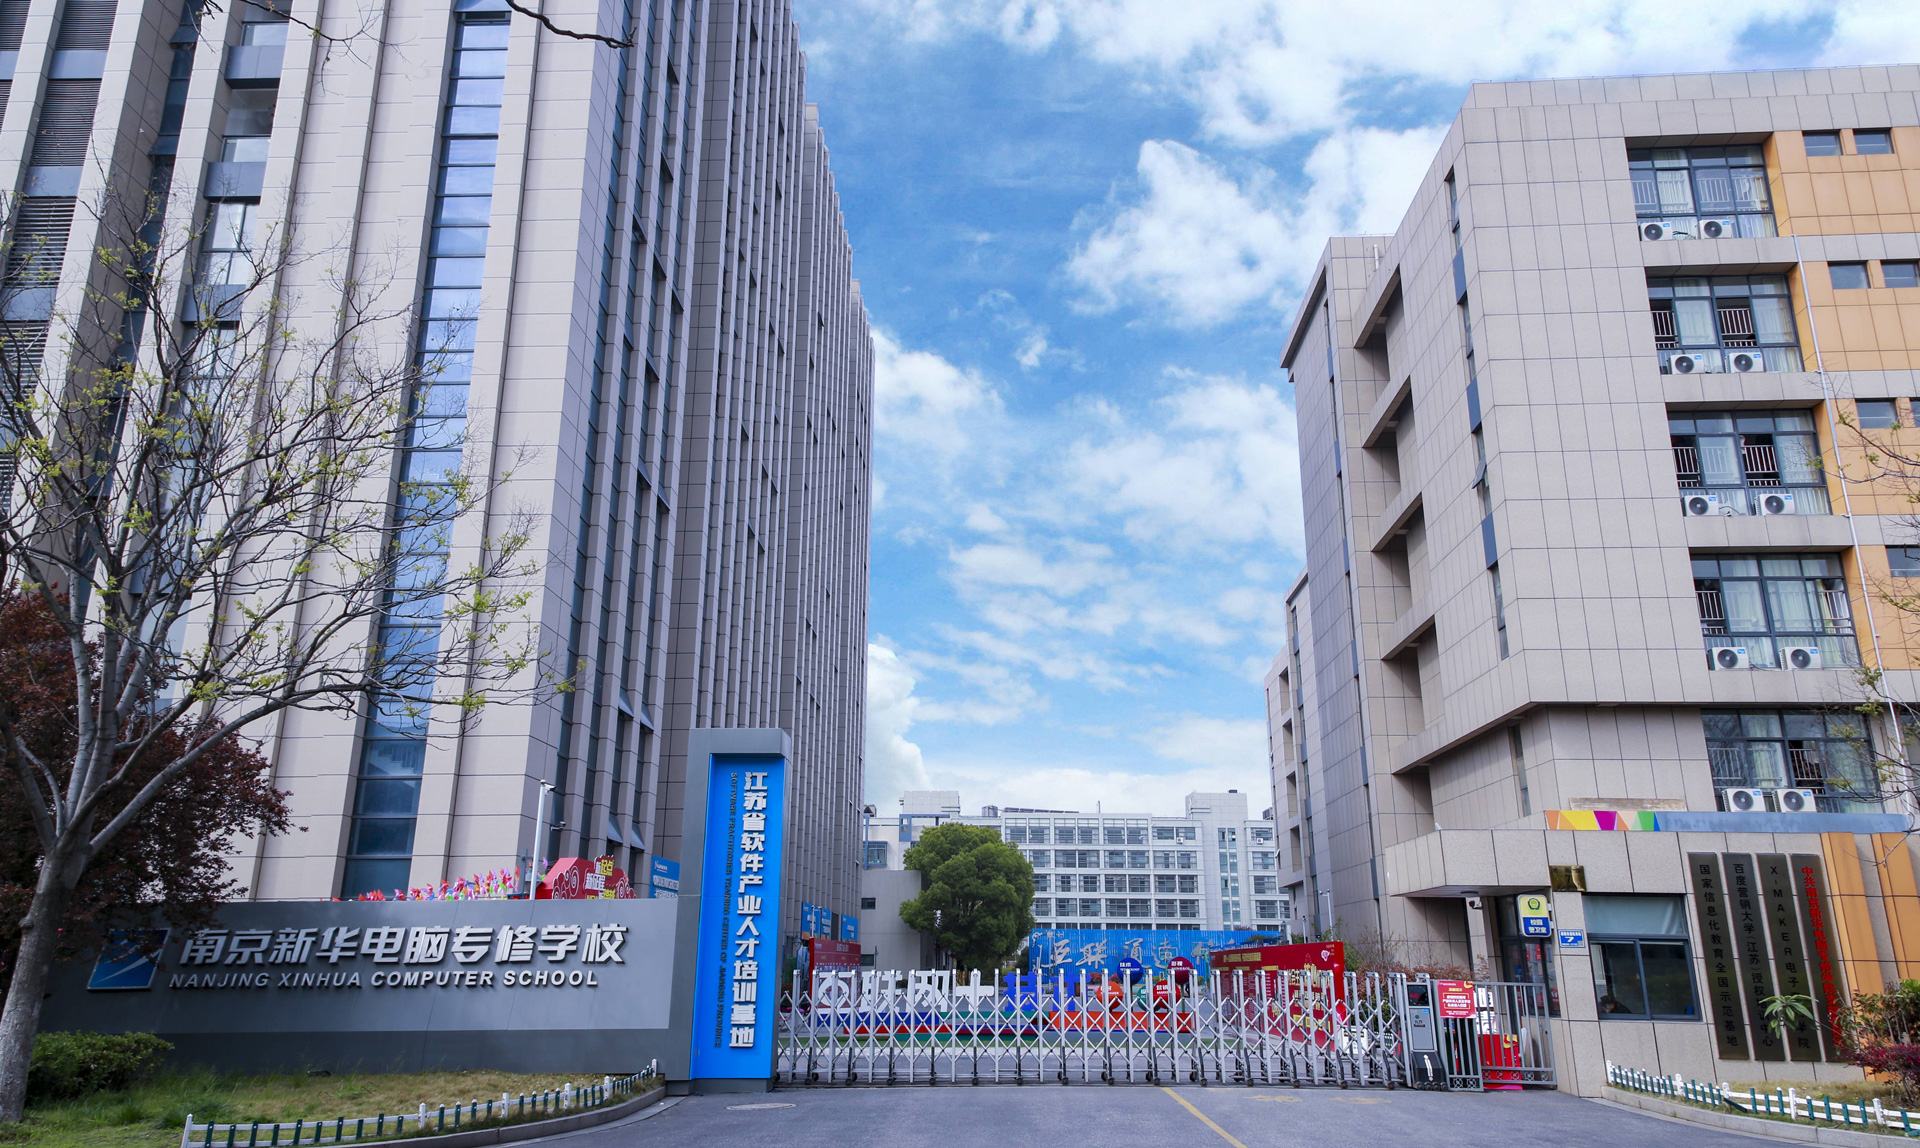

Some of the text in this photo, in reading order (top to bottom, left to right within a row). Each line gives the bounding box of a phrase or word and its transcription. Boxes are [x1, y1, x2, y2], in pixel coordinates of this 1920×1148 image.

[169, 968, 599, 990] NANJING XINHUA COMPUTER SCHOOL
[179, 924, 629, 965] 南京新华电脑专修学校
[714, 772, 738, 1048] SOFTWARE PRACTITIONER TRAINING CENTER OF JIANGSU PROVINCE
[729, 771, 768, 1048] 江苏省软件产业人才培训基地
[1699, 864, 1738, 1046] 国家信息化教育全国示范基地
